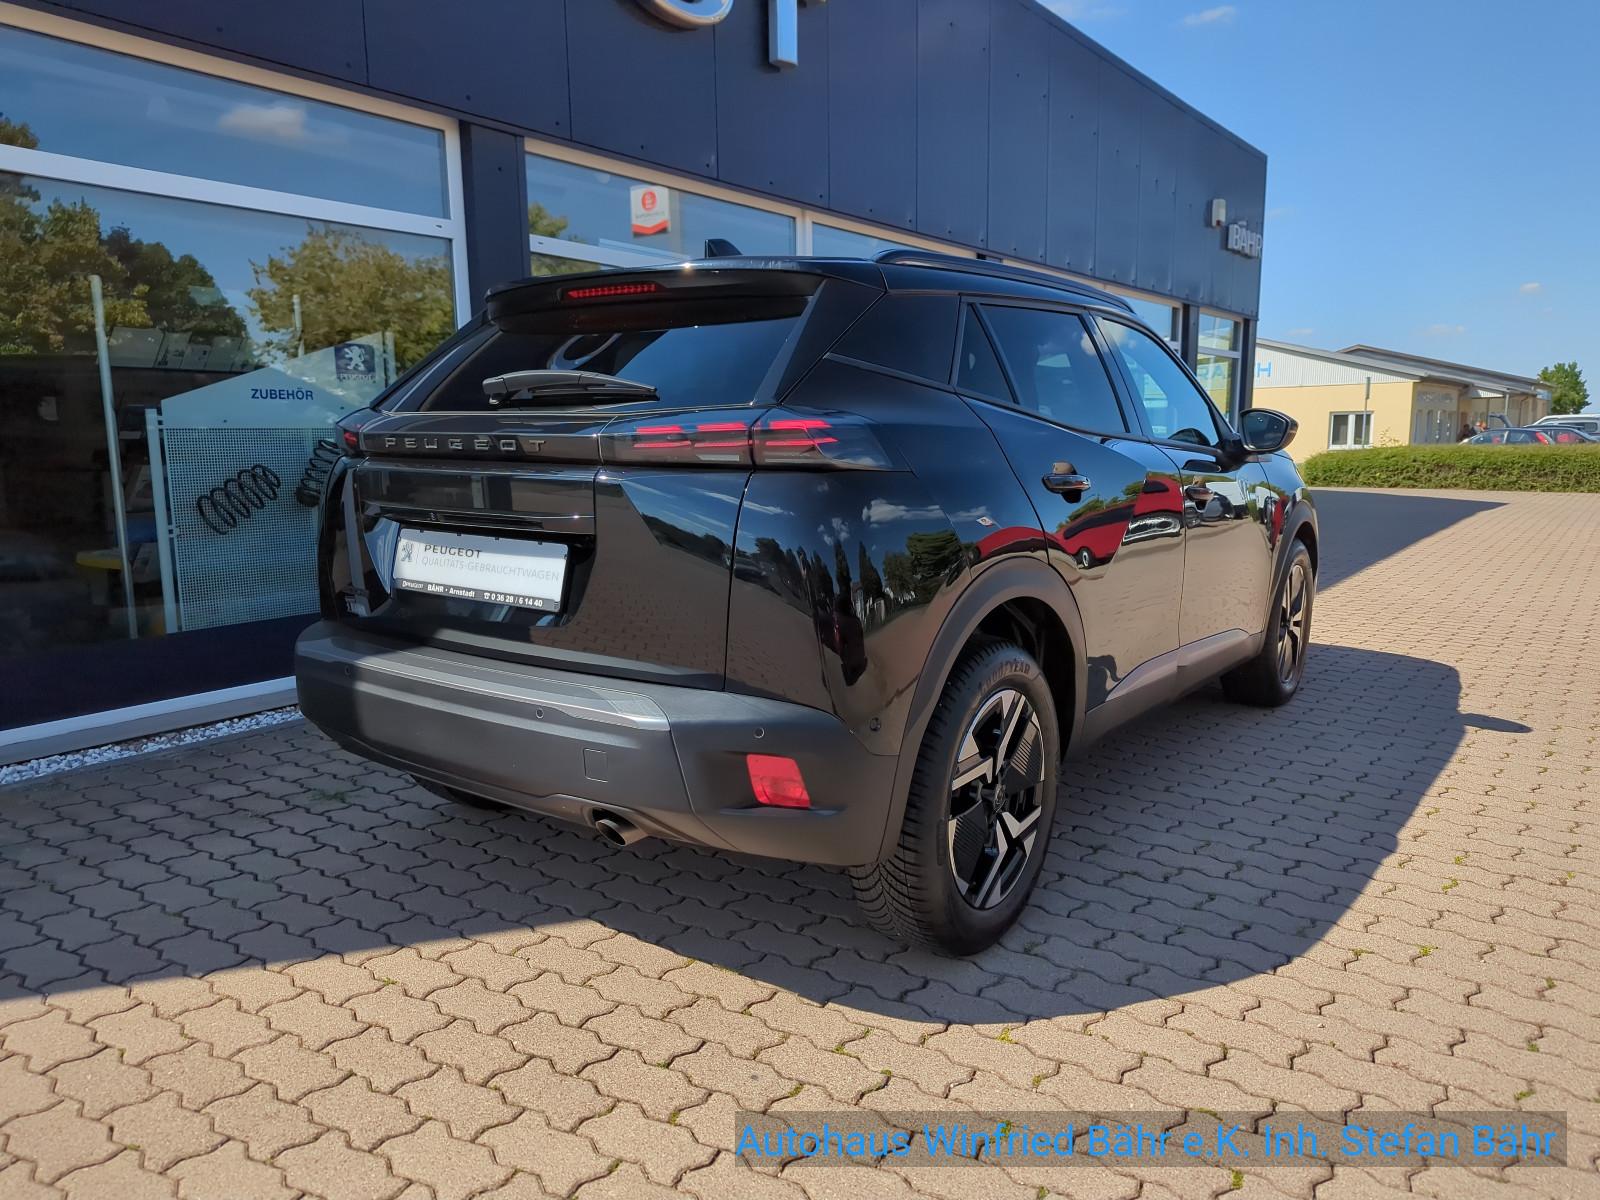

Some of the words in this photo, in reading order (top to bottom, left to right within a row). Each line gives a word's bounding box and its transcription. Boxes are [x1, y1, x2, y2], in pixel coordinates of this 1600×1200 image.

[251, 387, 314, 400] ZUBEHÖR
[384, 437, 545, 452] PEUGEOT
[424, 544, 482, 558] PEUGEOT
[427, 584, 444, 592] BÄHR
[449, 588, 475, 597] Arnstadt
